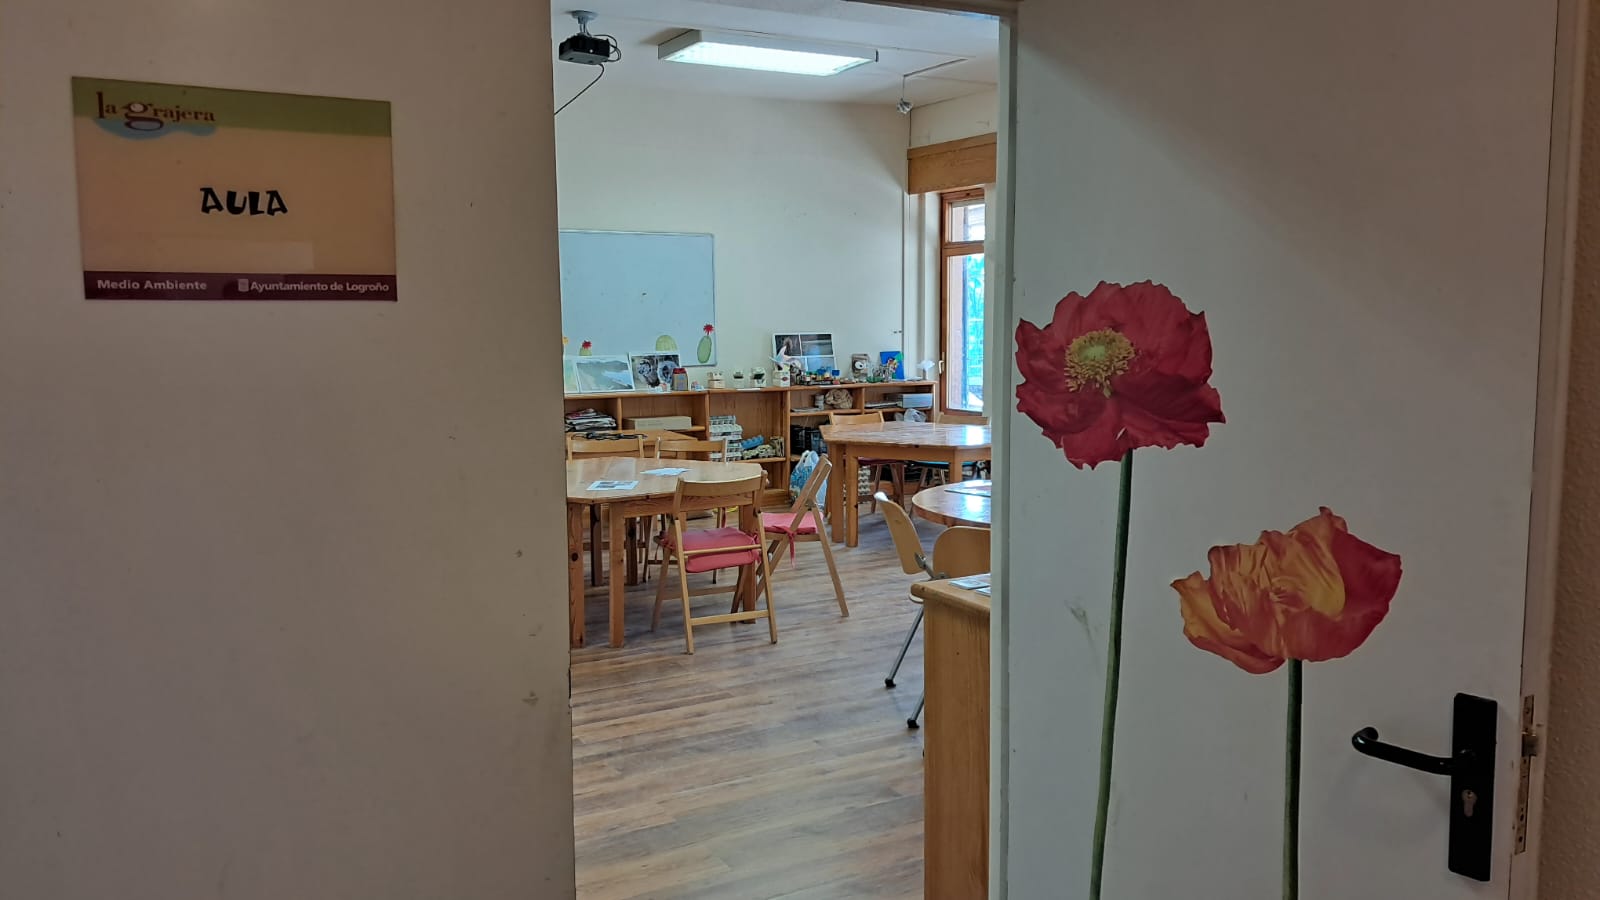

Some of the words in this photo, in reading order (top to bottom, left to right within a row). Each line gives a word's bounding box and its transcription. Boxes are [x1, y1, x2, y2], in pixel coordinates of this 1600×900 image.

[96, 91, 118, 119] la
[121, 102, 216, 131] grajera
[200, 187, 288, 215] AULA
[96, 279, 140, 290] Medio
[144, 280, 208, 291] Ambiente
[250, 281, 328, 293] Ayuntamiento
[330, 282, 344, 292] de
[346, 282, 390, 294] Logroño
